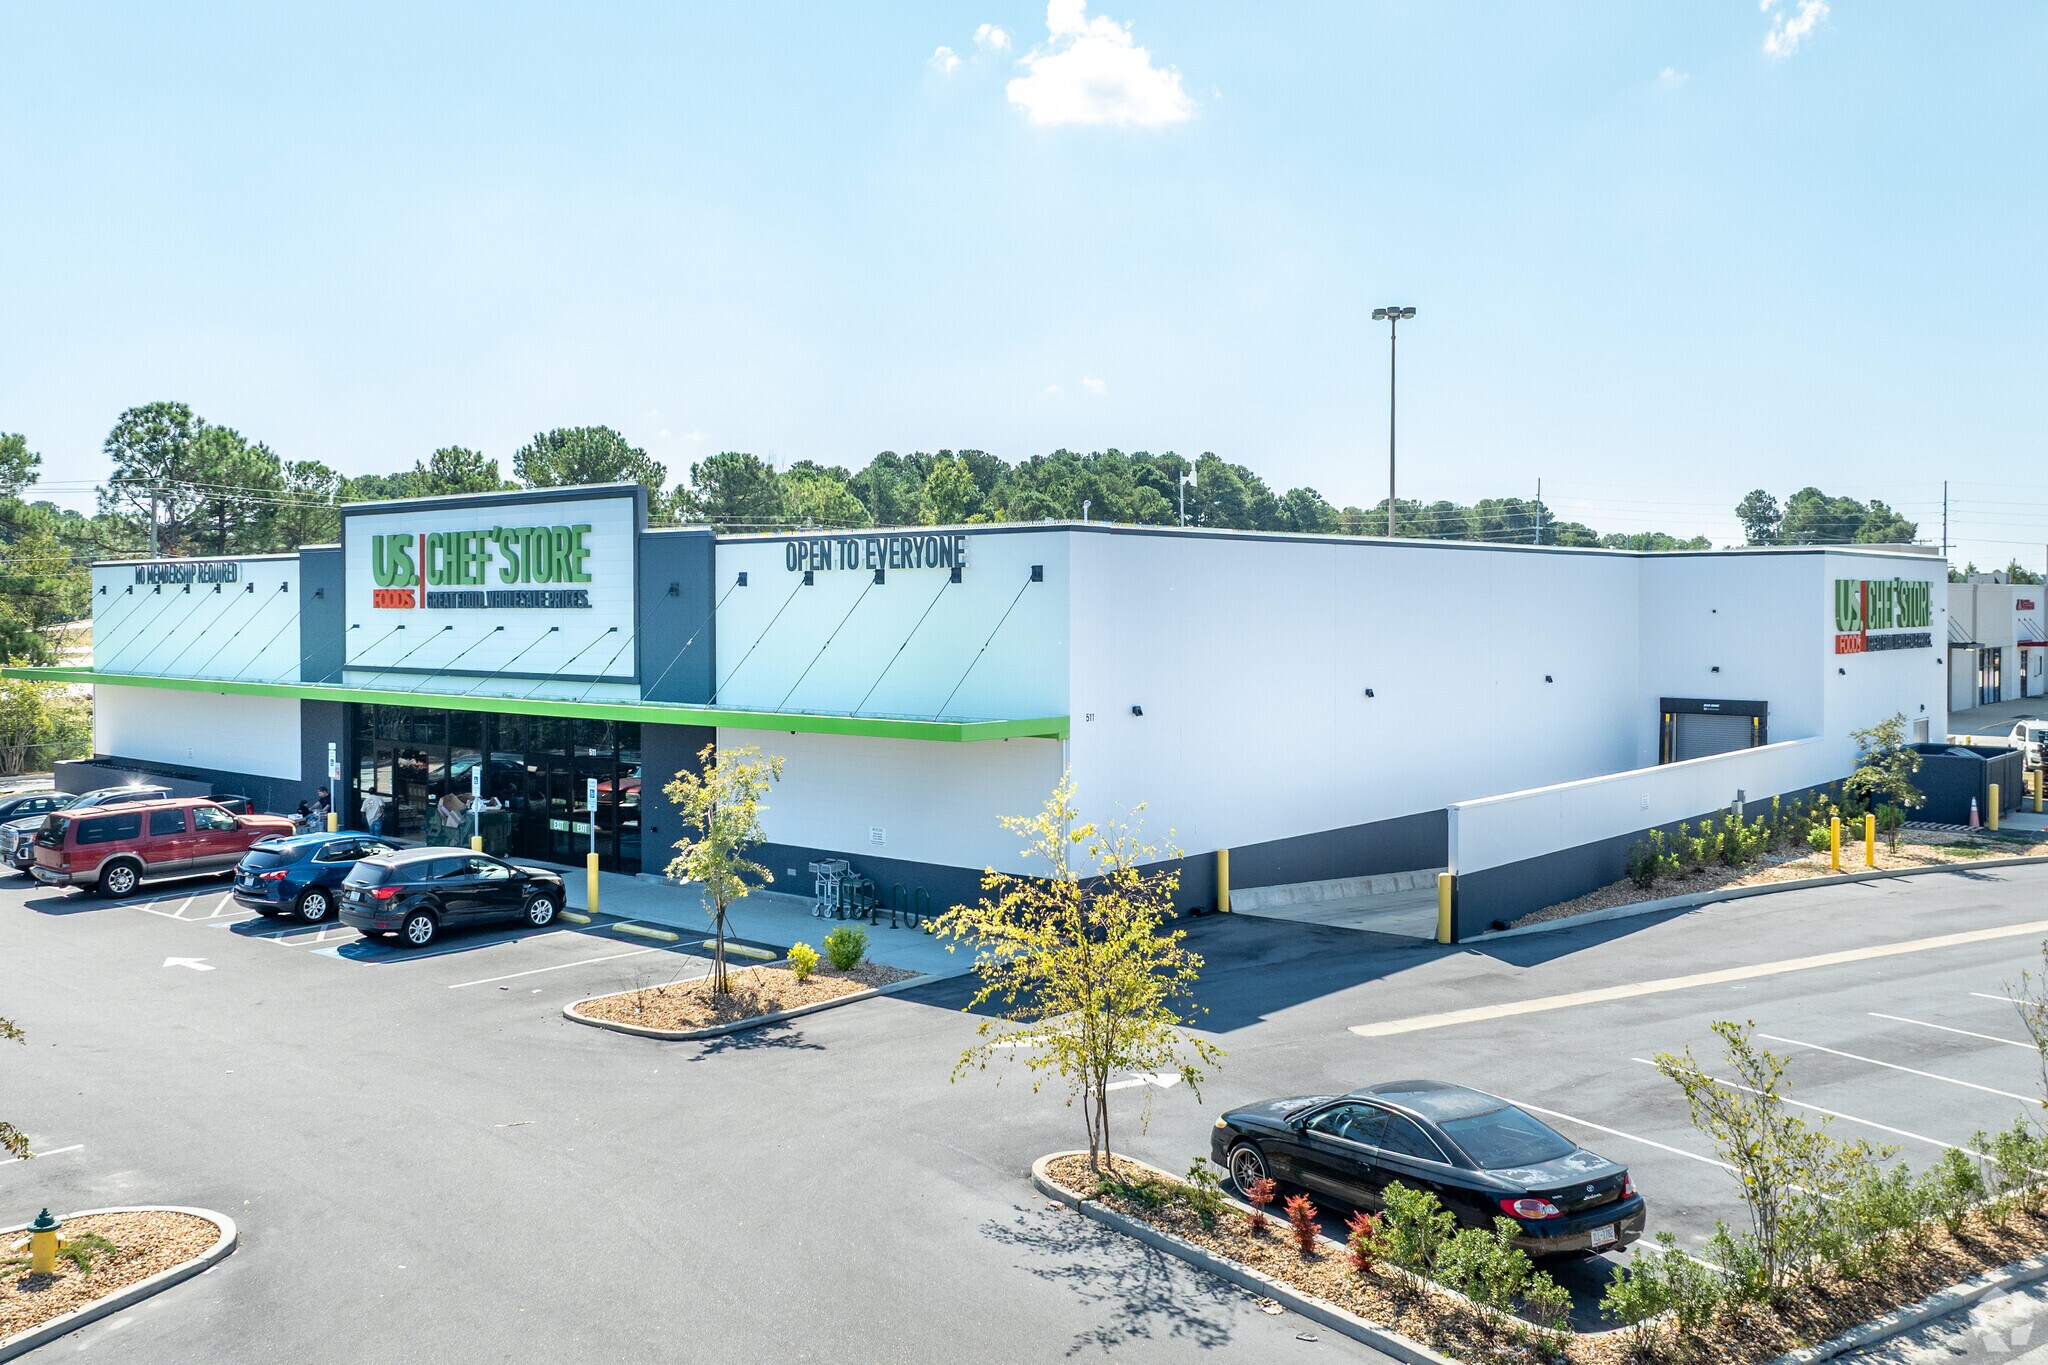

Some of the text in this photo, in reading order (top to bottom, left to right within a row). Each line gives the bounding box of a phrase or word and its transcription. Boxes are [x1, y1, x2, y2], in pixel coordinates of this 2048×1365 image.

[426, 524, 592, 586] CHEF'STORE
[785, 535, 966, 572] OPEN TO EVERYONE
[135, 562, 238, 585] NO MEMBERSHIP REQUIRED
[373, 588, 416, 609] FOODS
[427, 590, 456, 609] GREAT
[487, 590, 546, 609] WHOLESALE
[1866, 577, 1934, 630] CHEF'STORE
[1835, 633, 1862, 654] FOODS
[1085, 712, 1095, 722] 511
[588, 748, 597, 756] 511
[576, 823, 588, 833] EXIT
